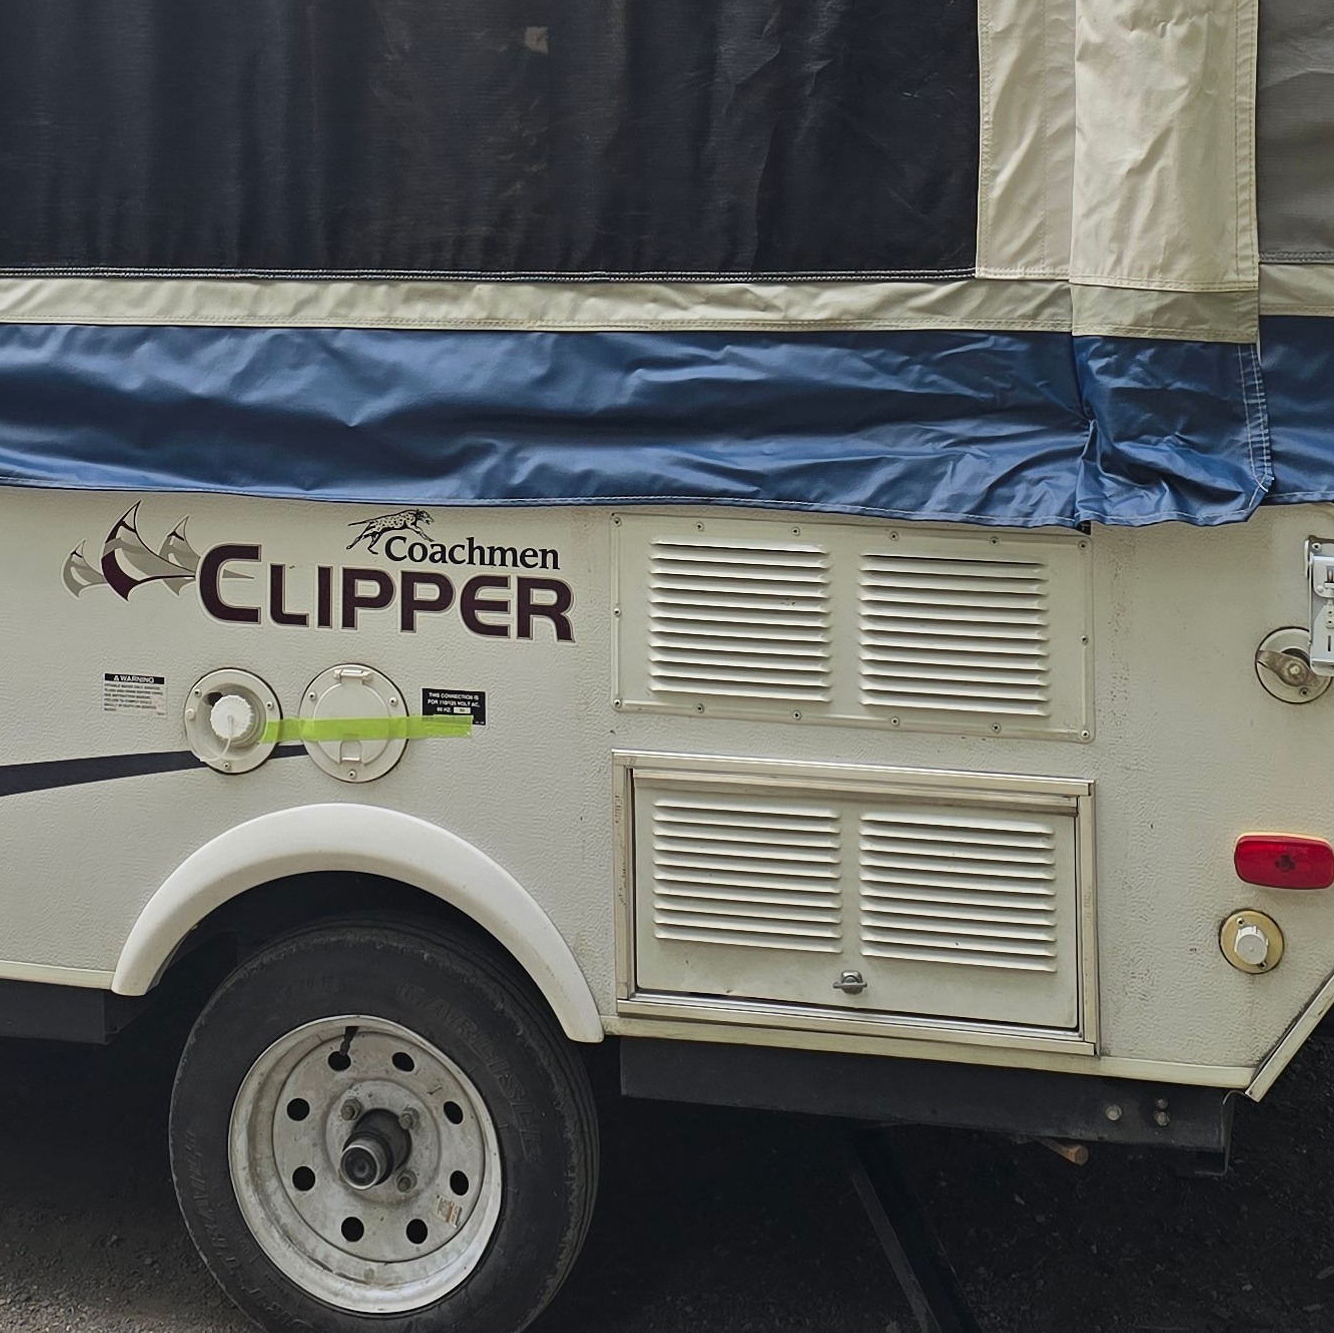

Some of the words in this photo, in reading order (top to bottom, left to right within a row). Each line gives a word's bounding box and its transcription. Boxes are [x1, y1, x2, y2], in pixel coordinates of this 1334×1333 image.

[384, 536, 561, 570] Coachmen
[199, 544, 576, 644] CLIPPER
[120, 675, 154, 683] WARNING
[395, 982, 542, 1163] CARLISLE
